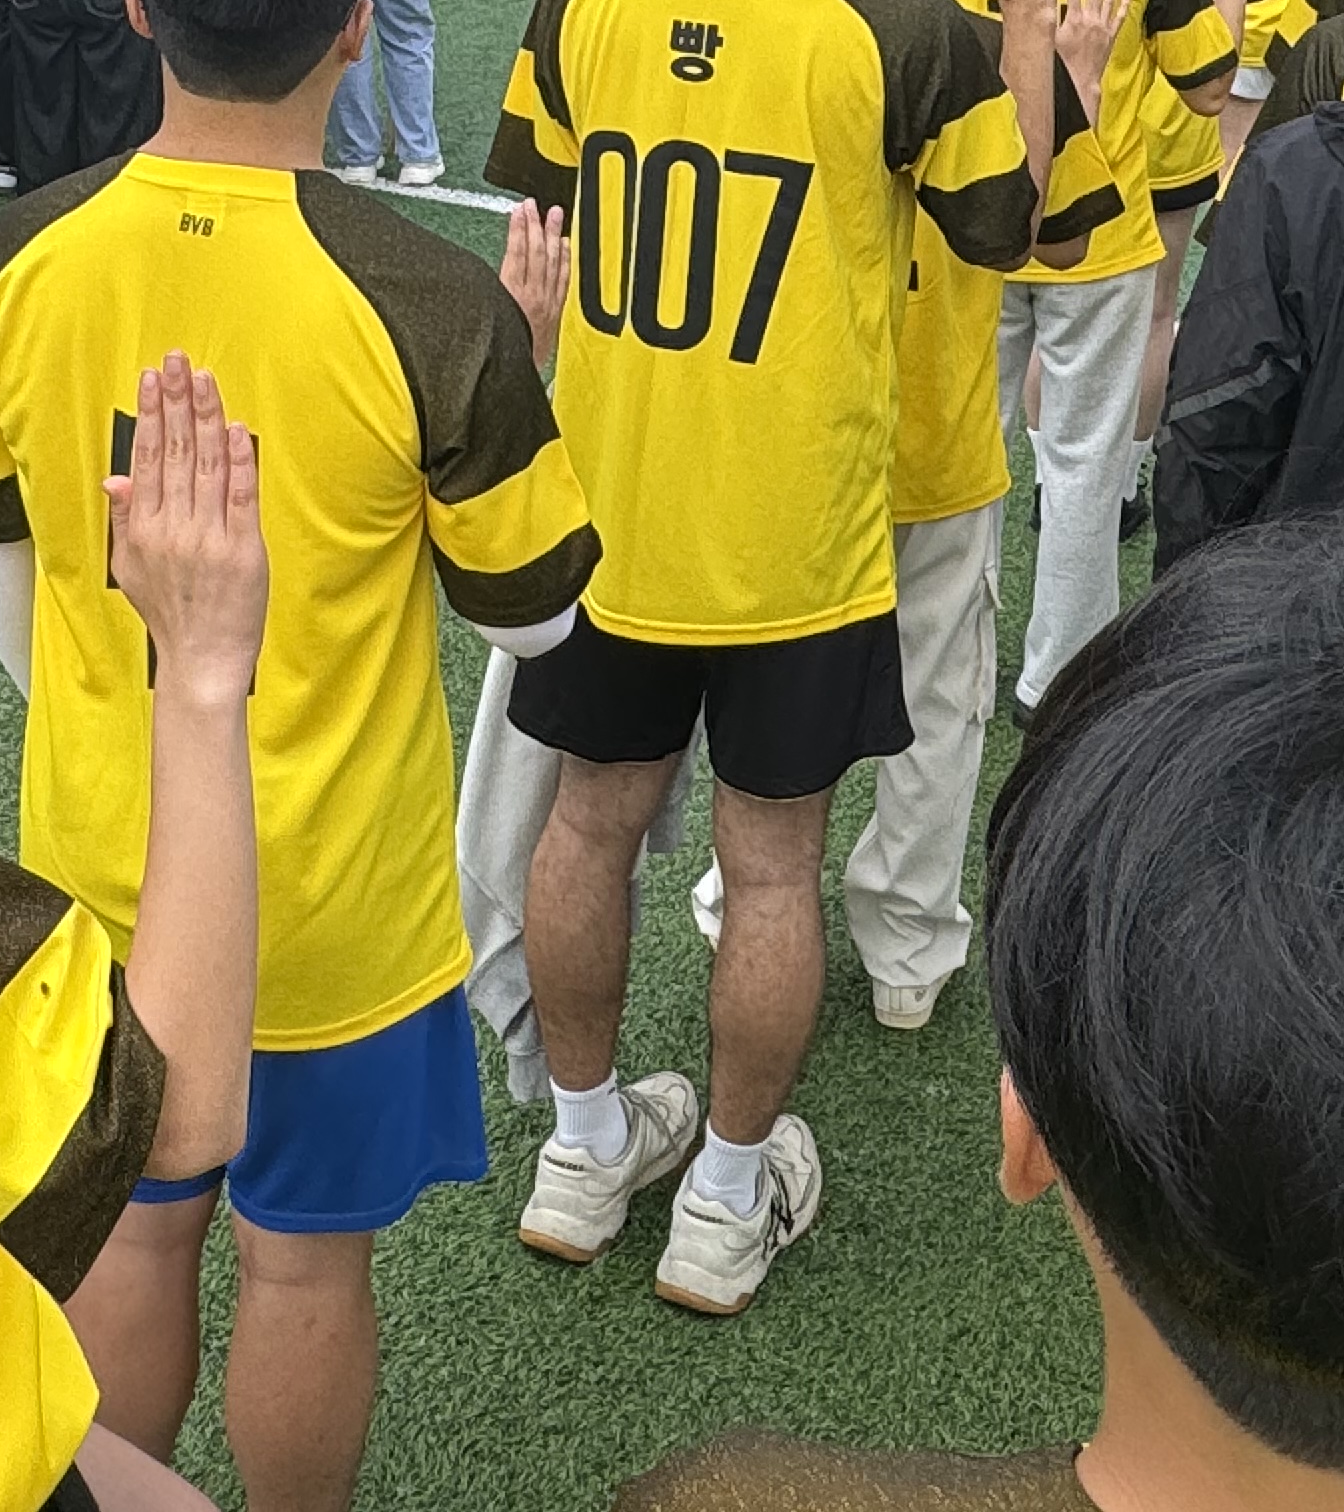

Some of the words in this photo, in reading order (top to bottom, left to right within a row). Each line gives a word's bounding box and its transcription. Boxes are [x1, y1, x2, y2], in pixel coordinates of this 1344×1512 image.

[670, 19, 724, 82] 빵
[178, 212, 215, 237] BVB
[578, 130, 815, 365] 007
